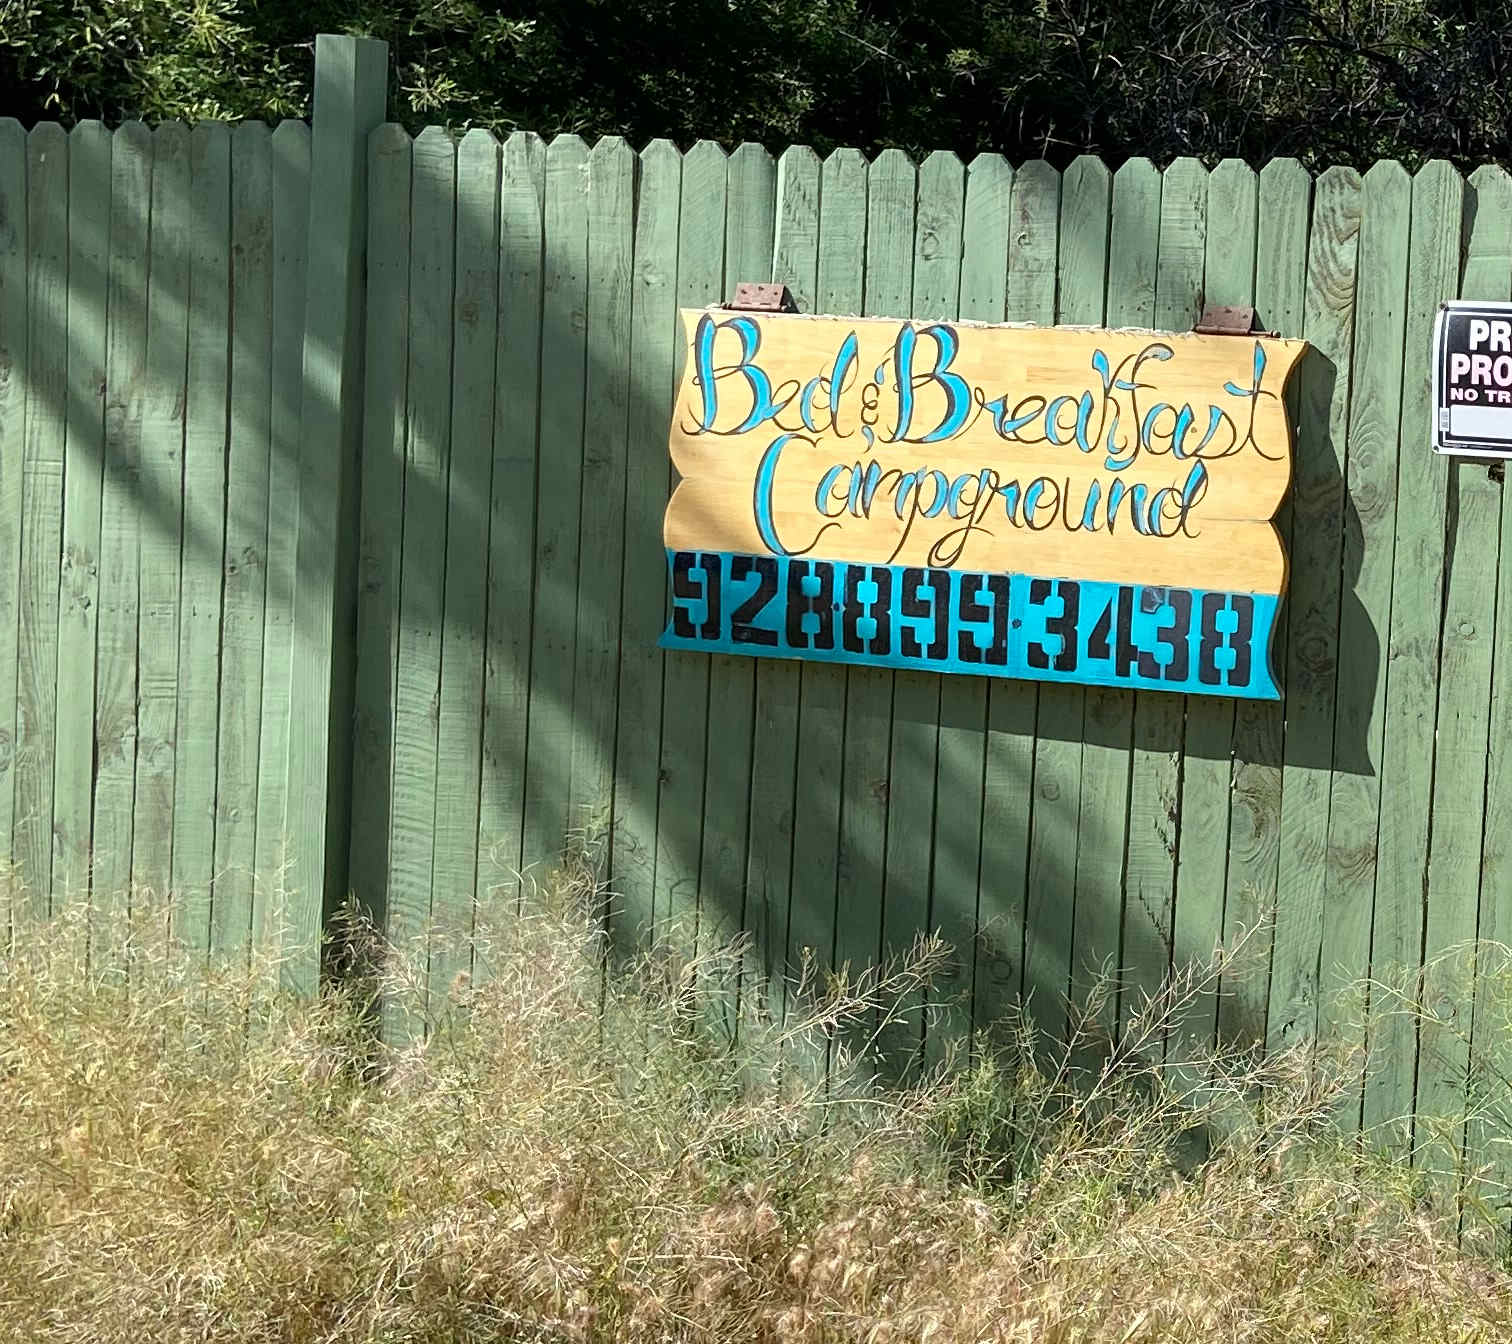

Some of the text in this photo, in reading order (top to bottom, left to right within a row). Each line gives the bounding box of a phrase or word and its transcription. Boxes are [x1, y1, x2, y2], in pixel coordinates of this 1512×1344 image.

[680, 312, 860, 440] Bed
[878, 321, 1285, 471] Breakfast
[1450, 388, 1479, 402] NO
[753, 433, 1209, 569] Campground
